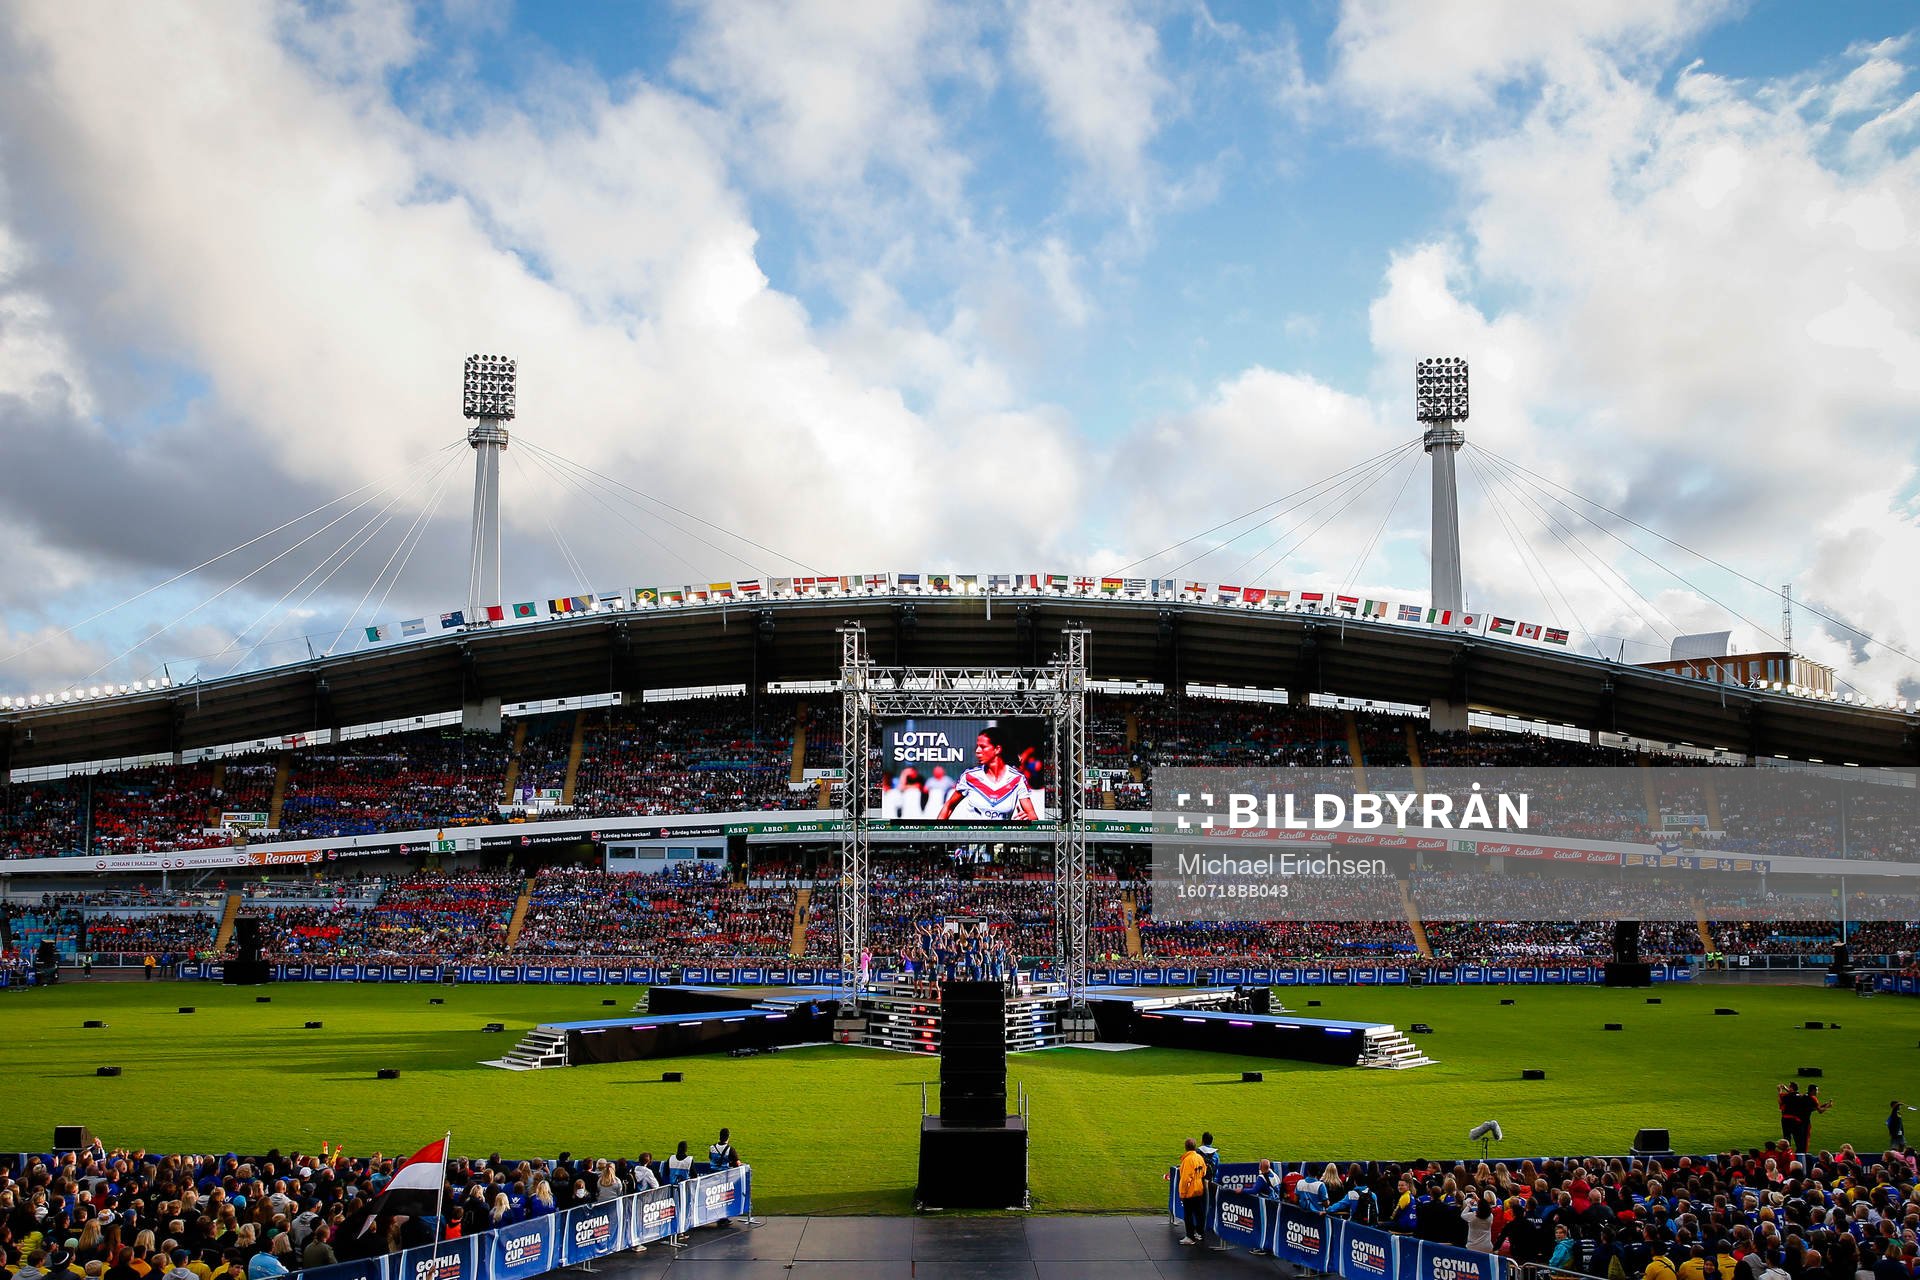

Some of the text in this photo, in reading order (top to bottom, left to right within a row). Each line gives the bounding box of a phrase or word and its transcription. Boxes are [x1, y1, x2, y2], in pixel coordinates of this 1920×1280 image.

[894, 732, 949, 746] LOTTA
[894, 747, 964, 762] SCHELIN
[1210, 828, 1236, 836] Estrella
[1241, 829, 1268, 838] Estrella
[1279, 830, 1305, 839] Estrella
[1347, 835, 1375, 843] Estrella
[1380, 837, 1407, 845] Estrella
[1417, 839, 1444, 848] Estrella
[1482, 844, 1510, 853] Estrella
[1515, 847, 1543, 855] Estrella
[1553, 850, 1582, 859] Estrella
[264, 853, 307, 864] Renova
[1587, 853, 1615, 861] Estrella
[1222, 1174, 1258, 1184] GOTHI
[705, 1181, 735, 1196] GOTHIA
[643, 1198, 676, 1214] GOTHIA
[705, 1194, 721, 1206] CUP
[1222, 1202, 1254, 1219] GOTHIA
[576, 1214, 610, 1232] GOTHIA
[643, 1212, 660, 1223] CUP
[1222, 1211, 1239, 1223] CUP
[576, 1229, 594, 1242] CUP
[1287, 1220, 1320, 1240] GOTHIA
[506, 1233, 541, 1251] GOTHIA
[1286, 1230, 1303, 1243] CUP
[505, 1247, 524, 1262] CUP
[1352, 1239, 1385, 1258] GOTHIA
[1352, 1250, 1368, 1263] CUP
[416, 1254, 461, 1272] GOTHIA
[1432, 1256, 1480, 1275] GOTHIA
[1433, 1268, 1457, 1280] CUP
